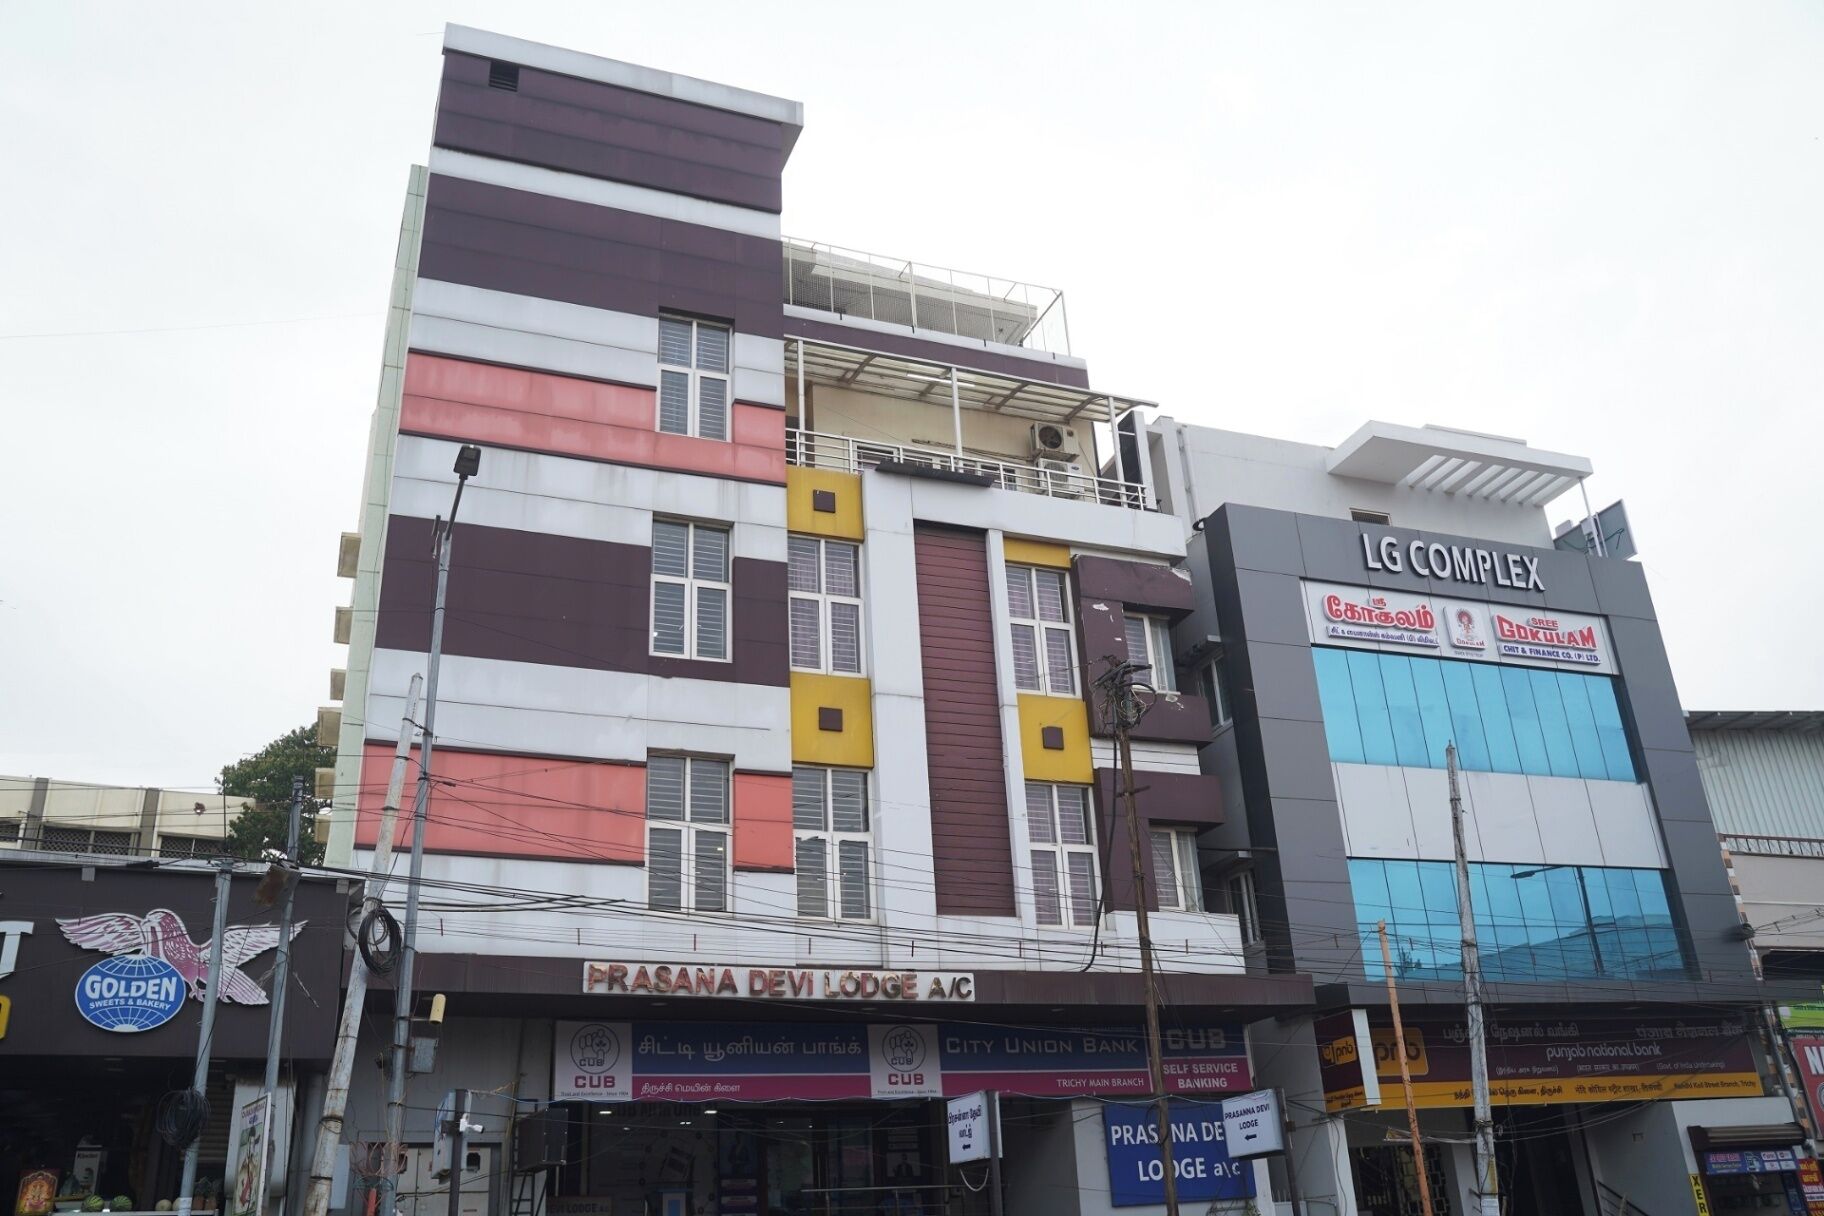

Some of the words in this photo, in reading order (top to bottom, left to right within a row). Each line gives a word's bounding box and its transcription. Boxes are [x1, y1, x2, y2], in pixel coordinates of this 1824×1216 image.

[1361, 532, 1403, 572] LG
[1408, 539, 1546, 591] COMPLEX
[1325, 594, 1435, 630] கோகுலம்
[1530, 617, 1559, 628] SREE
[1495, 614, 1597, 649] GOKULAM
[1503, 644, 1520, 654] CHIT
[1529, 648, 1561, 658] FINANCE
[1585, 654, 1601, 663] LTD.
[84, 974, 178, 1002] GOLDEN
[587, 963, 739, 995] PRASANA
[749, 967, 814, 997] DEVI
[824, 970, 920, 1000] LODGE
[927, 974, 973, 1001] A/C
[88, 998, 126, 1009] SWEETS
[127, 998, 135, 1006] &
[136, 998, 172, 1011] BAKERY
[945, 1036, 995, 1054] CITY
[1004, 1037, 1073, 1054] UNION
[1082, 1037, 1139, 1054] BANK
[1166, 1027, 1227, 1050] CUB
[637, 1034, 696, 1061] சிட்டி
[703, 1034, 796, 1062] யூனியன்
[802, 1034, 862, 1055] பாங்க்
[1335, 1038, 1354, 1062] pnb
[1546, 1043, 1586, 1061] punjab
[1586, 1042, 1634, 1057] national
[1634, 1042, 1662, 1056] bank
[579, 1058, 605, 1068] CUB
[890, 1056, 914, 1066] CUB
[1162, 1063, 1190, 1075] SELF
[1192, 1062, 1239, 1074] SERVICE
[574, 1075, 616, 1089] CUB
[887, 1073, 925, 1086] CUB
[1056, 1078, 1086, 1088] TRICHY
[1088, 1078, 1110, 1088] MAIN
[1111, 1077, 1145, 1088] BRANCH
[1177, 1077, 1228, 1090] BANKING
[640, 1083, 673, 1096] திருச்சி
[674, 1082, 712, 1094] மெயின்
[713, 1082, 741, 1093] கிளை
[1224, 1106, 1256, 1120] PRASANNA
[1256, 1103, 1270, 1113] DEVI
[1239, 1119, 1259, 1130] LODGE
[1110, 1121, 1199, 1146] PRASNA
[1201, 1121, 1225, 1143] DE
